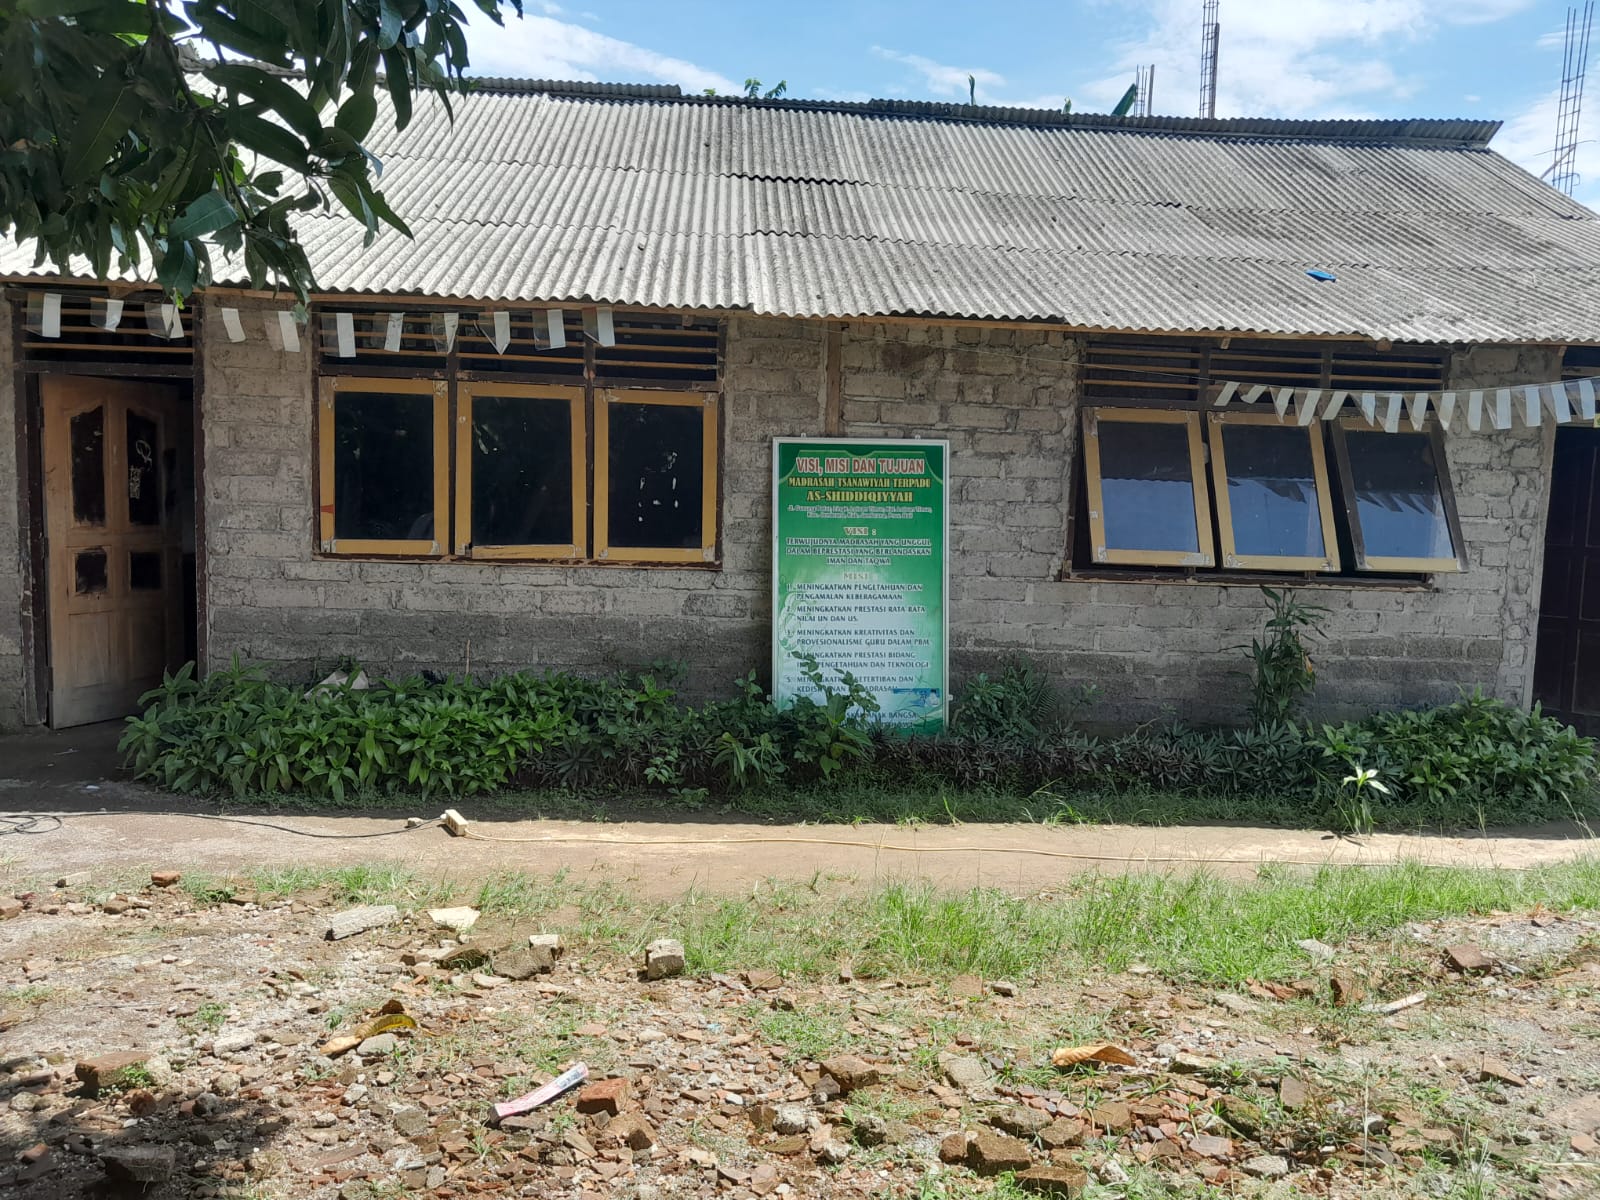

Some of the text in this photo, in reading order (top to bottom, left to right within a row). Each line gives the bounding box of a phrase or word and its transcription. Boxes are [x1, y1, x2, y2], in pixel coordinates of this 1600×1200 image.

[796, 457, 925, 476] VISI, MISI DAN TUJUAN
[788, 477, 931, 488] MADRASAH TSANAWIYAH TERPADU
[806, 490, 913, 503] AS-SHIDDIQIYYAH
[844, 527, 868, 536] VISI
[786, 538, 837, 547] TERWUJUDNYA
[839, 538, 878, 546] MADRASAH
[901, 539, 930, 547] UNGGUL
[786, 547, 811, 555] DALAM
[827, 557, 890, 566] IMAN DAN TAQWA
[843, 571, 868, 581] MISI
[796, 583, 852, 591] MENINGKATKAN
[854, 605, 886, 613] PRESTASI
[796, 638, 863, 646] PROVESIONALISME
[865, 638, 886, 646] GURU
[887, 638, 912, 646] DALAM
